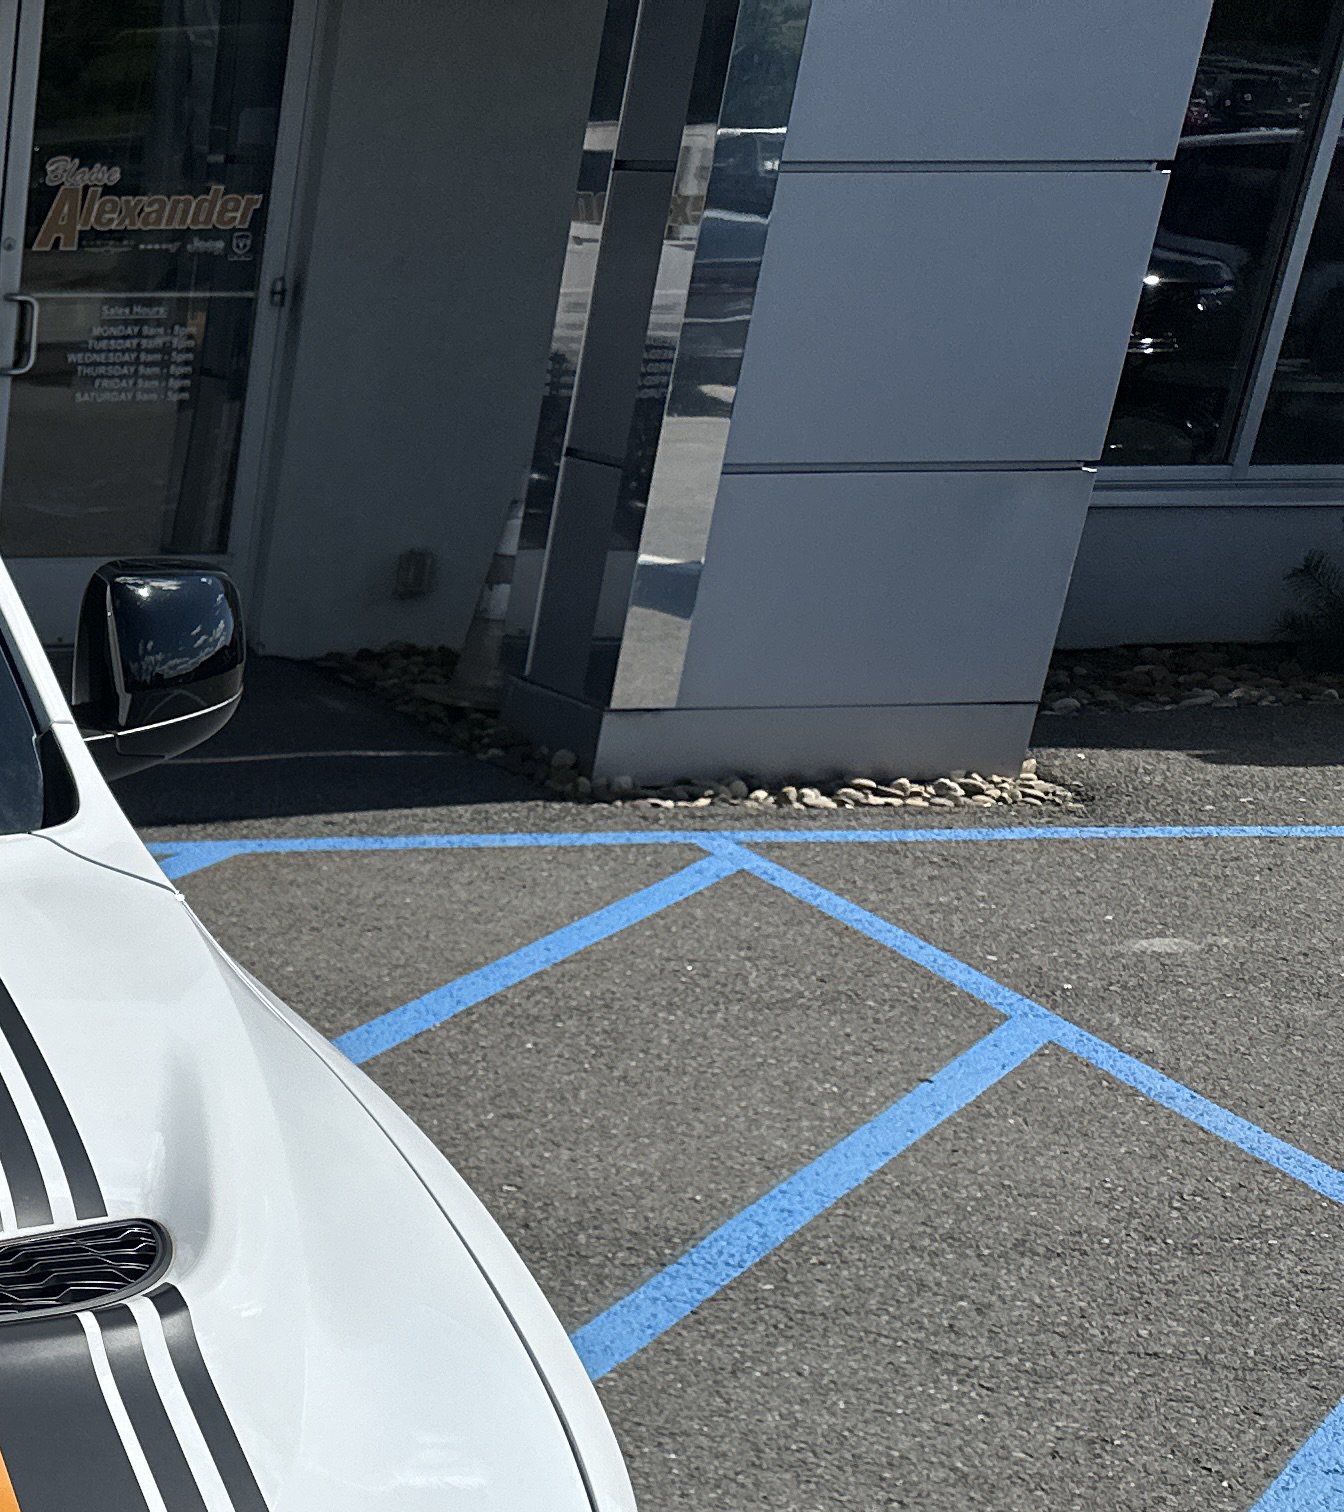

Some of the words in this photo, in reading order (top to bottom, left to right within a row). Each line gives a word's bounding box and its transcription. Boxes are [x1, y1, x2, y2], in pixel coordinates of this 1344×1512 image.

[45, 155, 122, 187] Blaise
[32, 184, 263, 251] Alexander
[102, 304, 130, 315] Sales
[93, 325, 140, 336] MONDAY
[88, 338, 137, 349] TUESDAY
[67, 352, 137, 363] WEDNESDAY
[77, 365, 135, 376] THURSDAY
[94, 378, 134, 388] FRIDAY
[75, 390, 132, 401] SATURDAY
